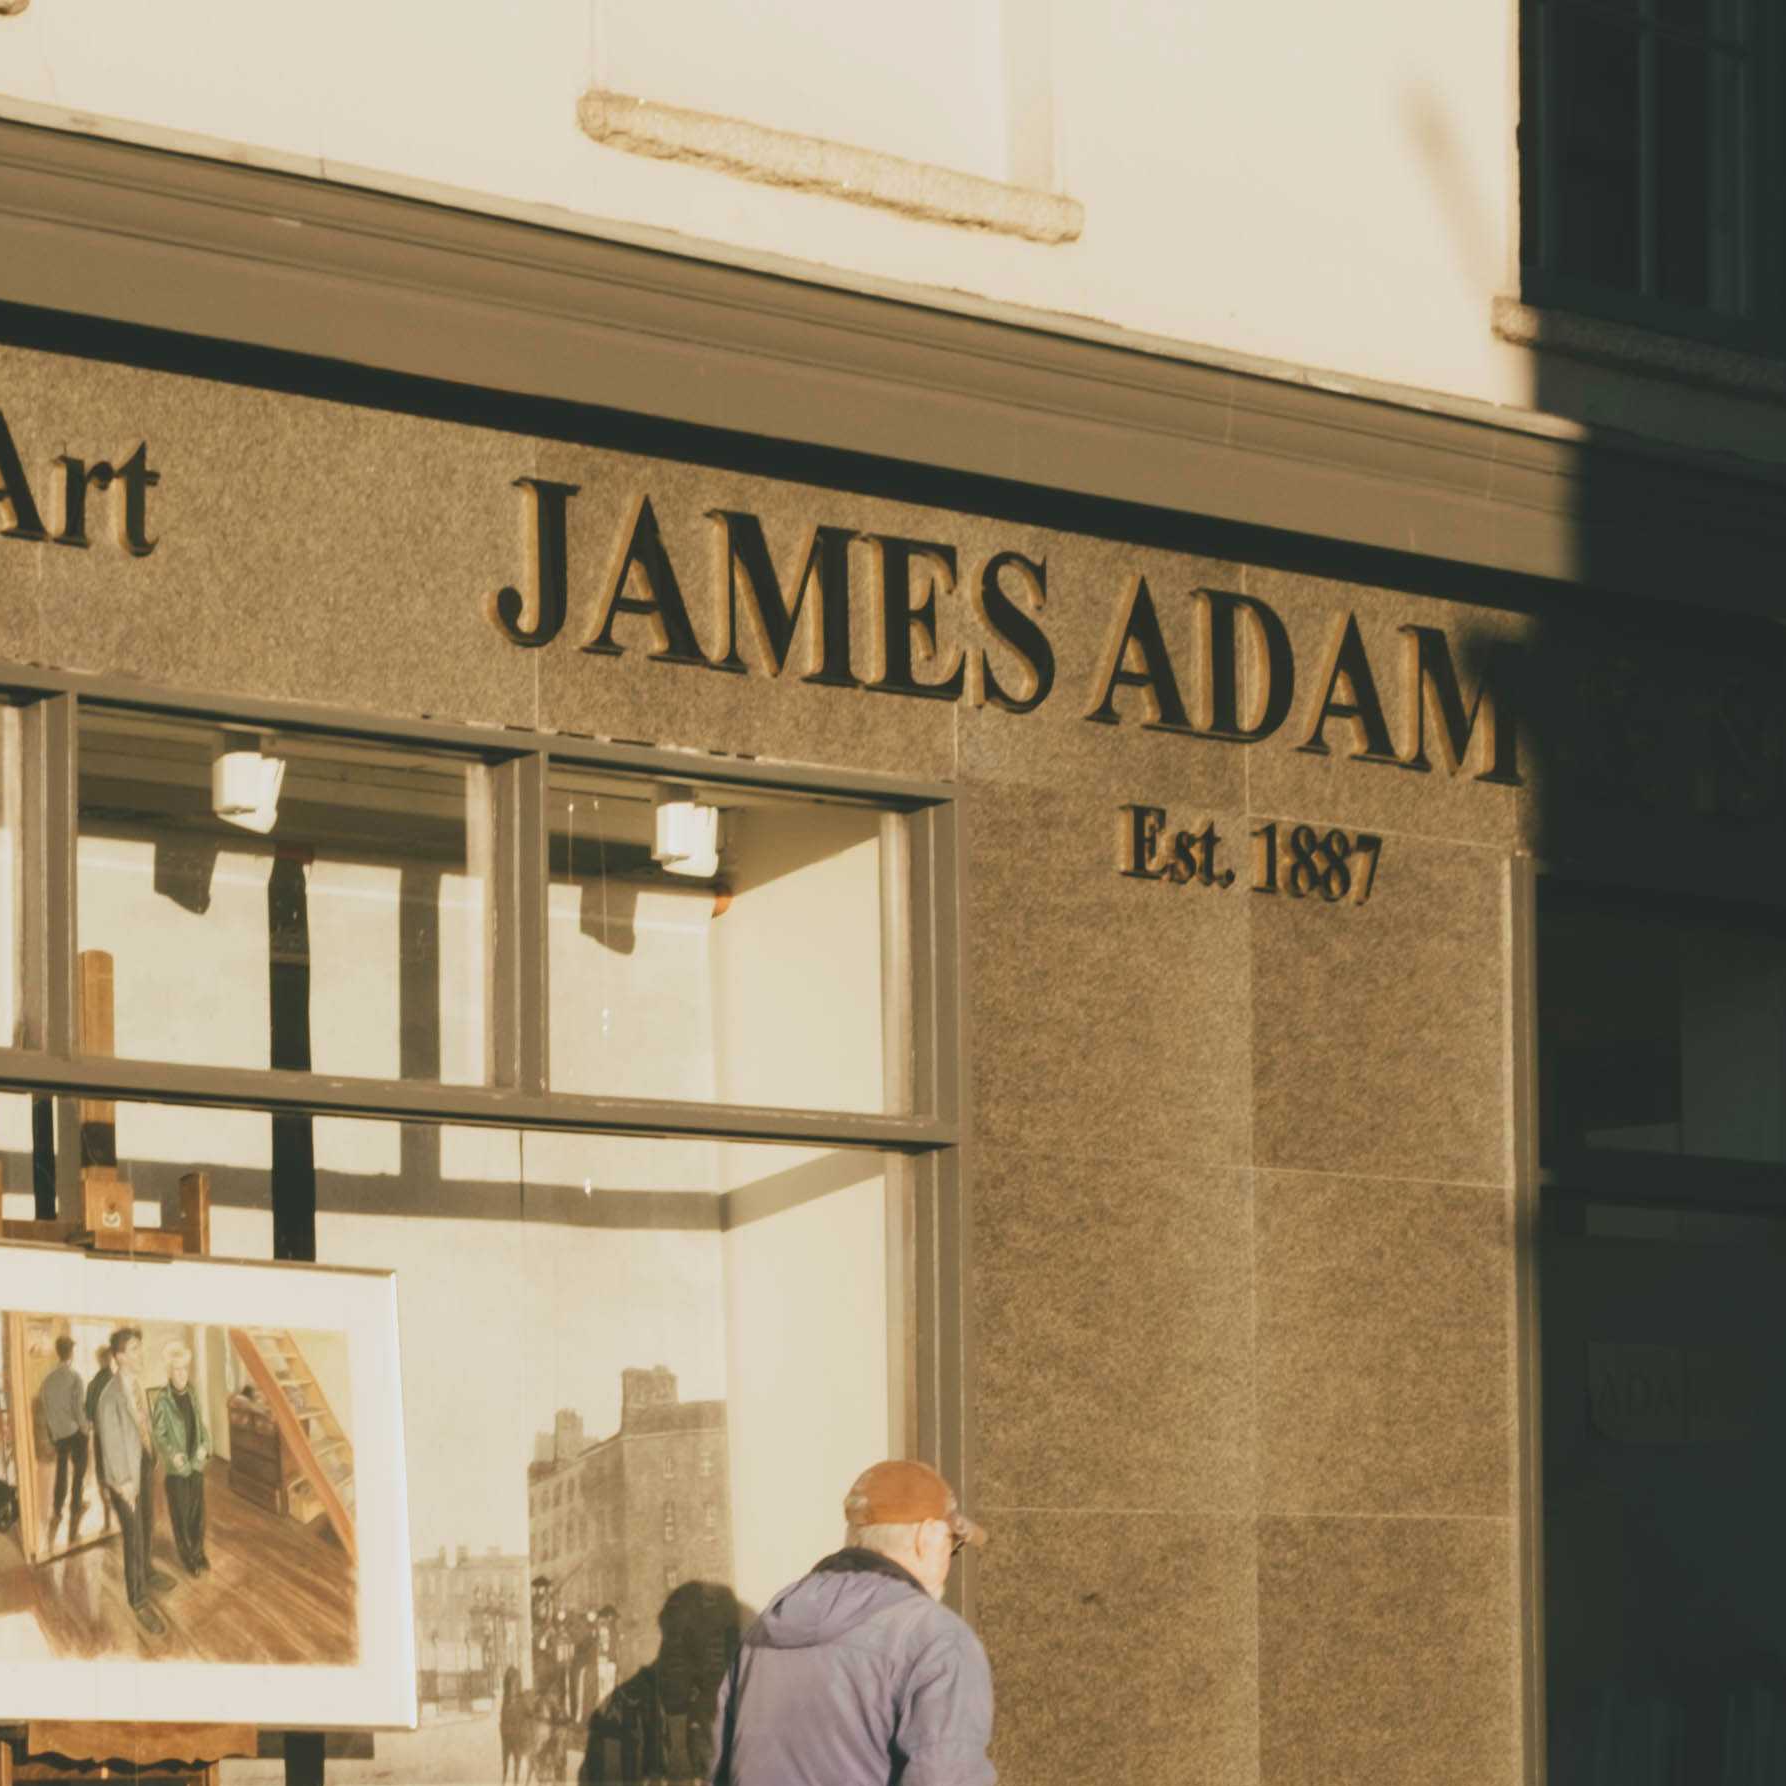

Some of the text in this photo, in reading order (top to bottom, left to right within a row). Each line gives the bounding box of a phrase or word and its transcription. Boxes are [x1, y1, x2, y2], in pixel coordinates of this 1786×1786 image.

[489, 476, 1055, 715] JAMES
[1083, 574, 1525, 787] ADAM
[1118, 803, 1384, 906] Est. 1887
